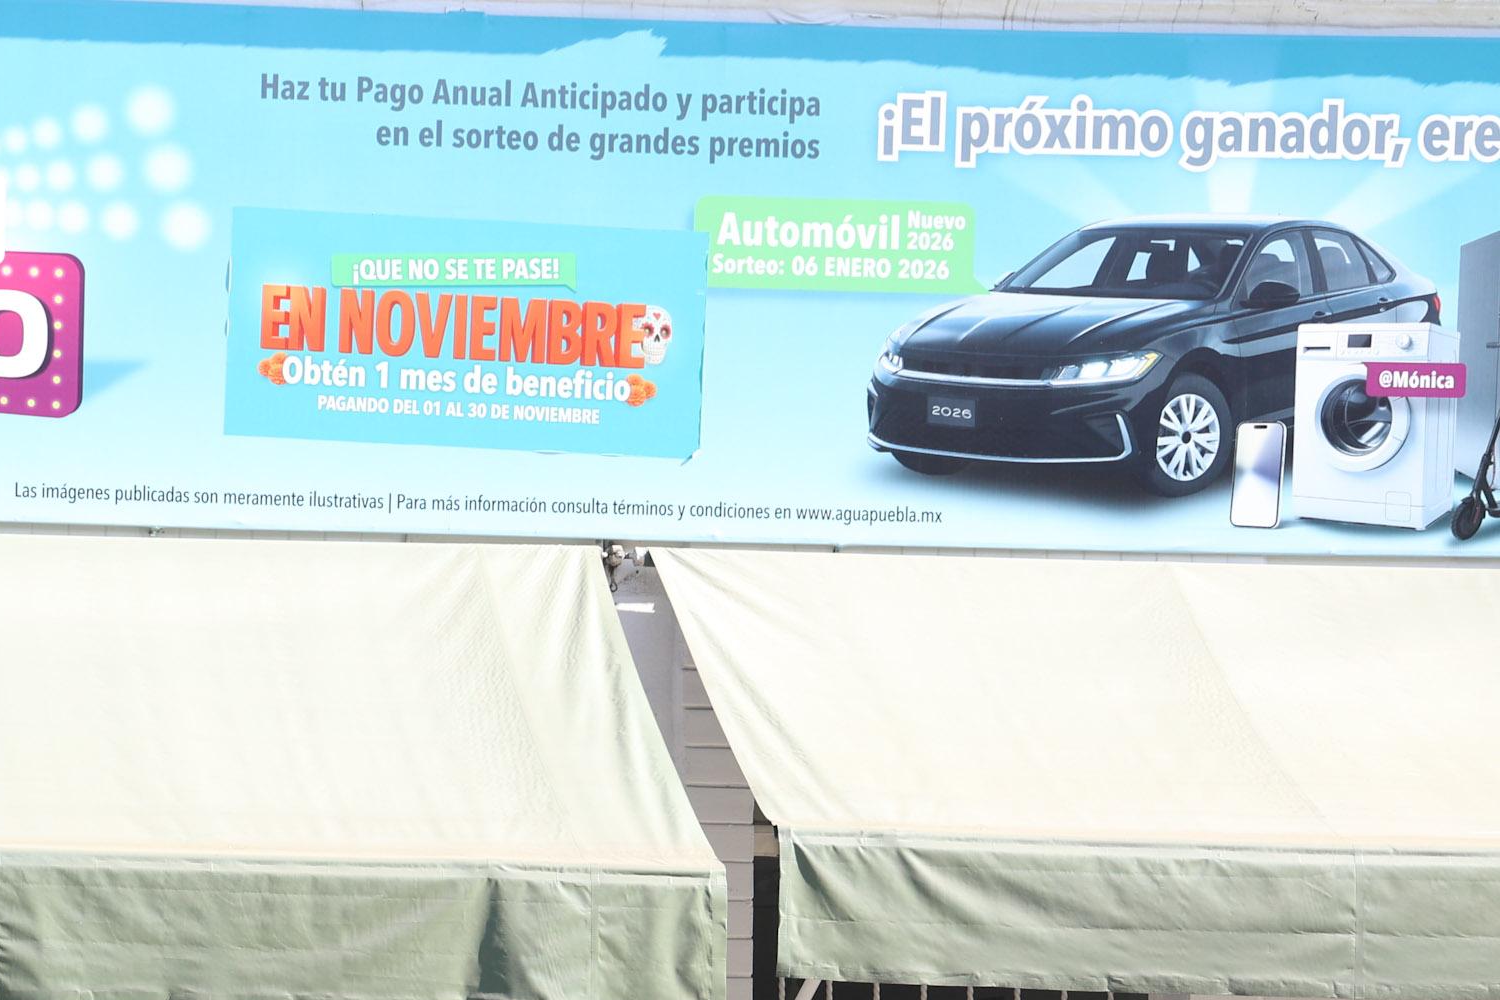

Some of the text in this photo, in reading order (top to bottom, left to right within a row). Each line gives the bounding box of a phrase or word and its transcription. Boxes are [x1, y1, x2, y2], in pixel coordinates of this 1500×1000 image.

[261, 72, 821, 124] Haz tu Pago Anual Anticipado y participa
[376, 119, 820, 164] en el sorteo de grandes premios
[880, 93, 944, 159] ¡El
[957, 97, 1171, 165] próximo
[1181, 101, 1408, 169] ganador,
[717, 211, 899, 251] Automóvil
[907, 210, 966, 230] Nuevo
[906, 232, 955, 251] 2026
[353, 258, 560, 285] ¡QUE NO SE TE PASE!
[712, 253, 950, 280] Sorteo: 06 ENERO 2026
[260, 284, 647, 369] EN NOVIEMBRE
[282, 355, 631, 402] Obtén 1 mes de beneficio
[1379, 370, 1455, 389] @Mónica
[317, 394, 600, 425] PAGANDO DEL 01 AL 30 DE NOVIEMBRE
[931, 405, 972, 419] 2026
[15, 482, 942, 526] Las imágenes publicadas son meramente ilustrativas Para más información consulta términos y condiciones en www.aguapuebla.mx
